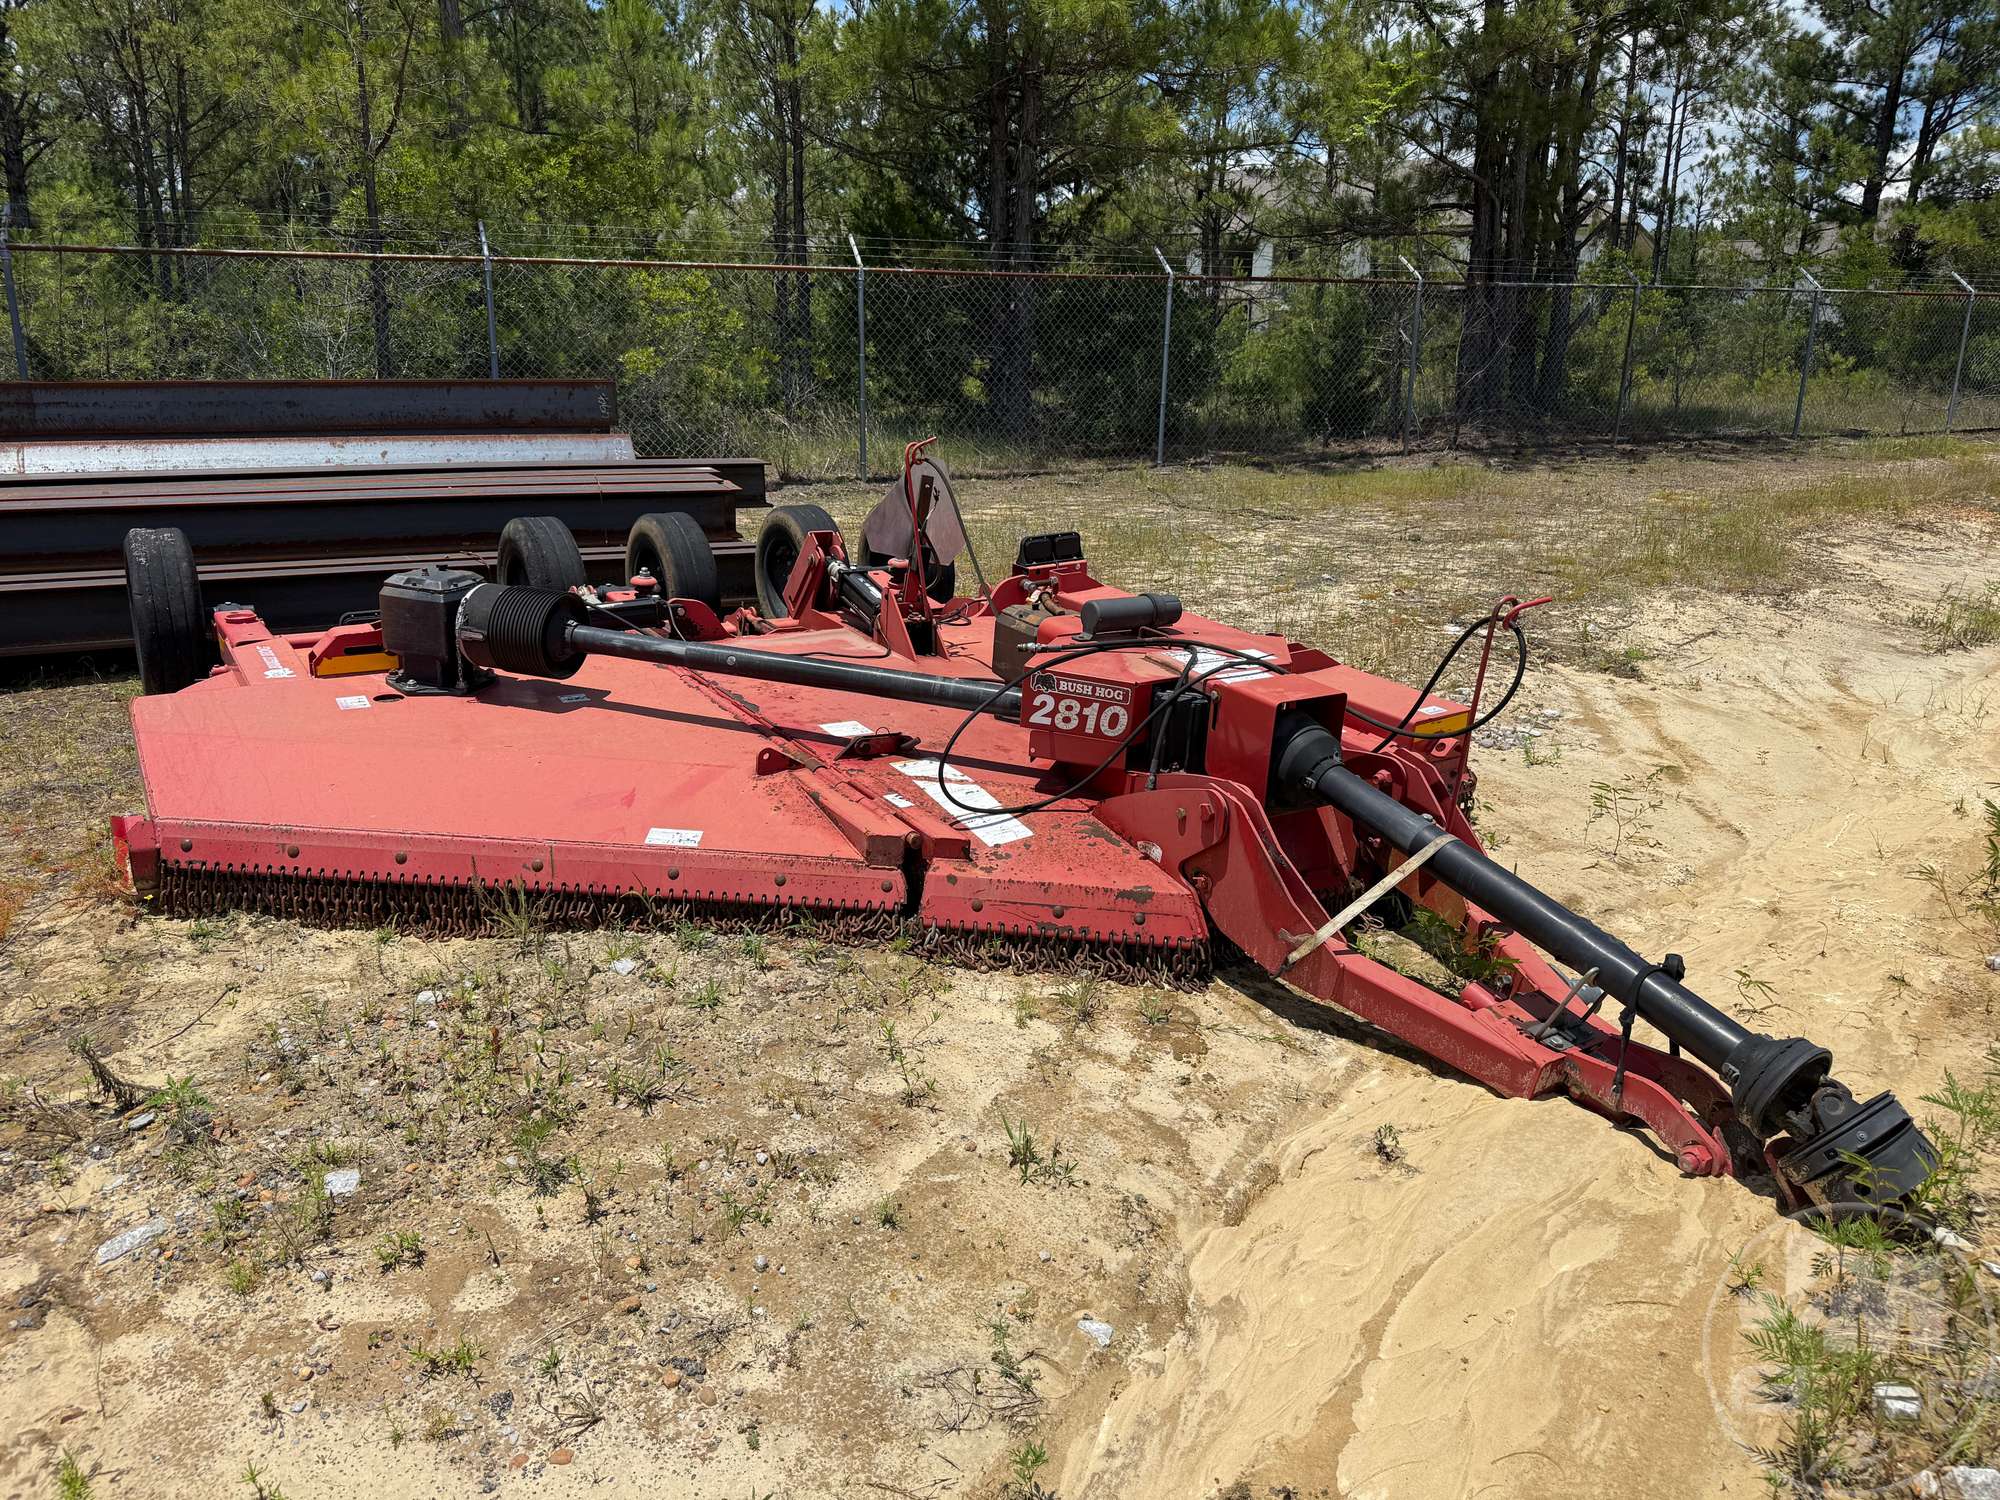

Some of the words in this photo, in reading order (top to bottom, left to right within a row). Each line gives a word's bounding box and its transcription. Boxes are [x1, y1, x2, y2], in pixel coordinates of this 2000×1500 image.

[1058, 680, 1092, 695] BUSH
[1095, 686, 1124, 700] HOG
[1028, 694, 1128, 736] 2810
